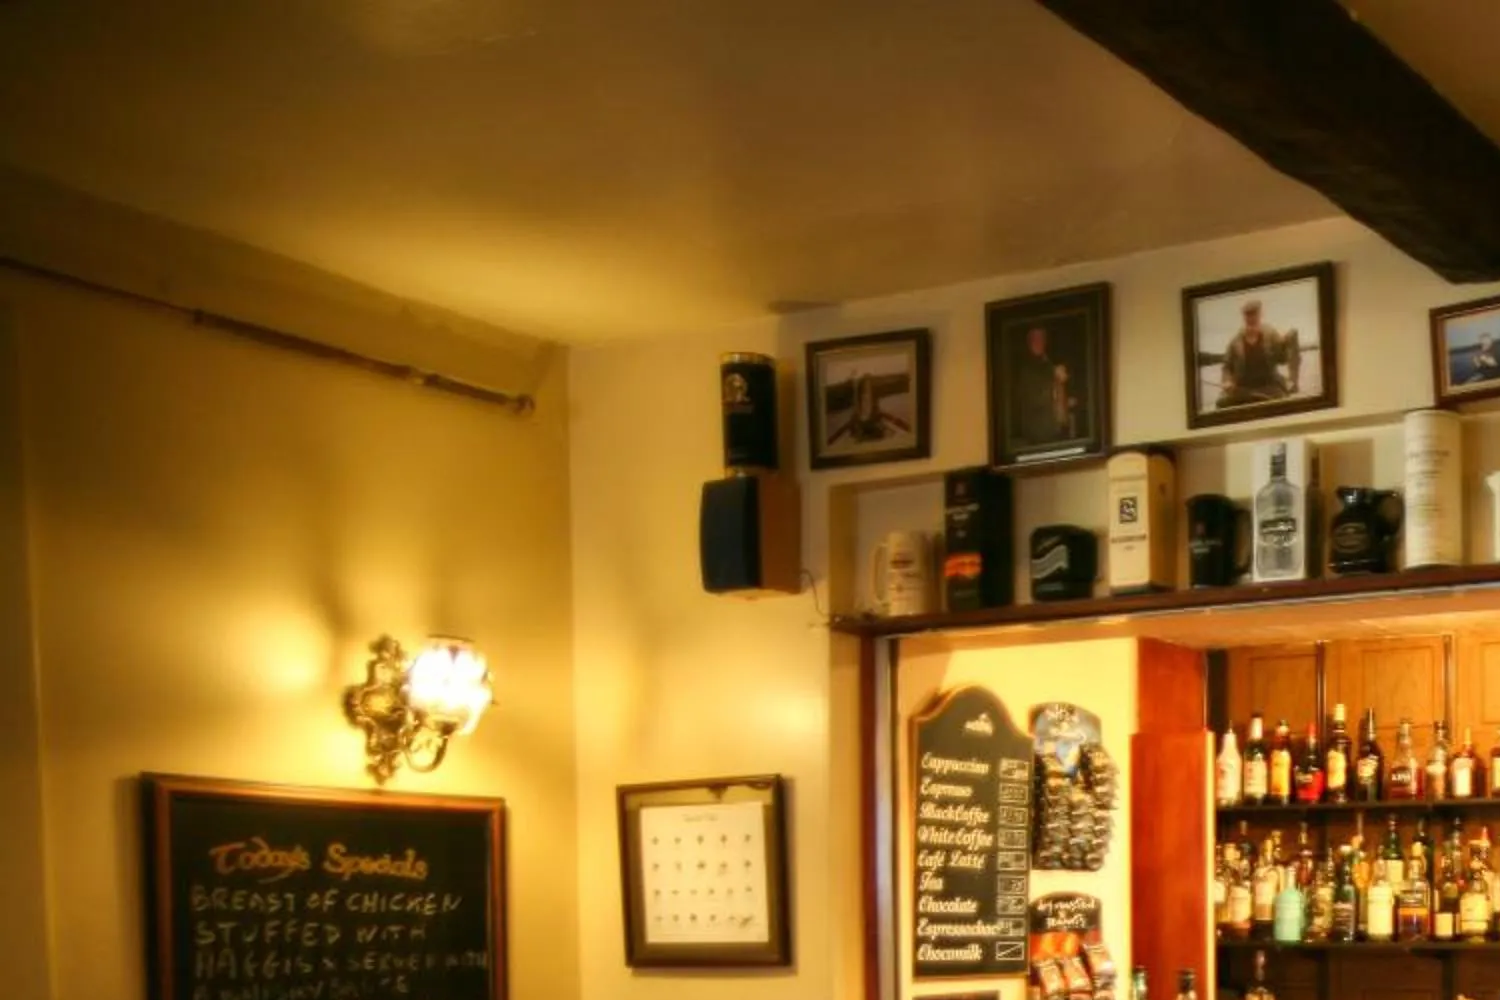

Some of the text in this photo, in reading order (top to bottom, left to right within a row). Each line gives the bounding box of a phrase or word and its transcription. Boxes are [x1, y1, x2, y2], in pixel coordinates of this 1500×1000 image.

[191, 884, 465, 916] BREAST OF CHICKEN
[194, 919, 428, 948] STUFFED WITH
[194, 948, 314, 980] HAGGIS
